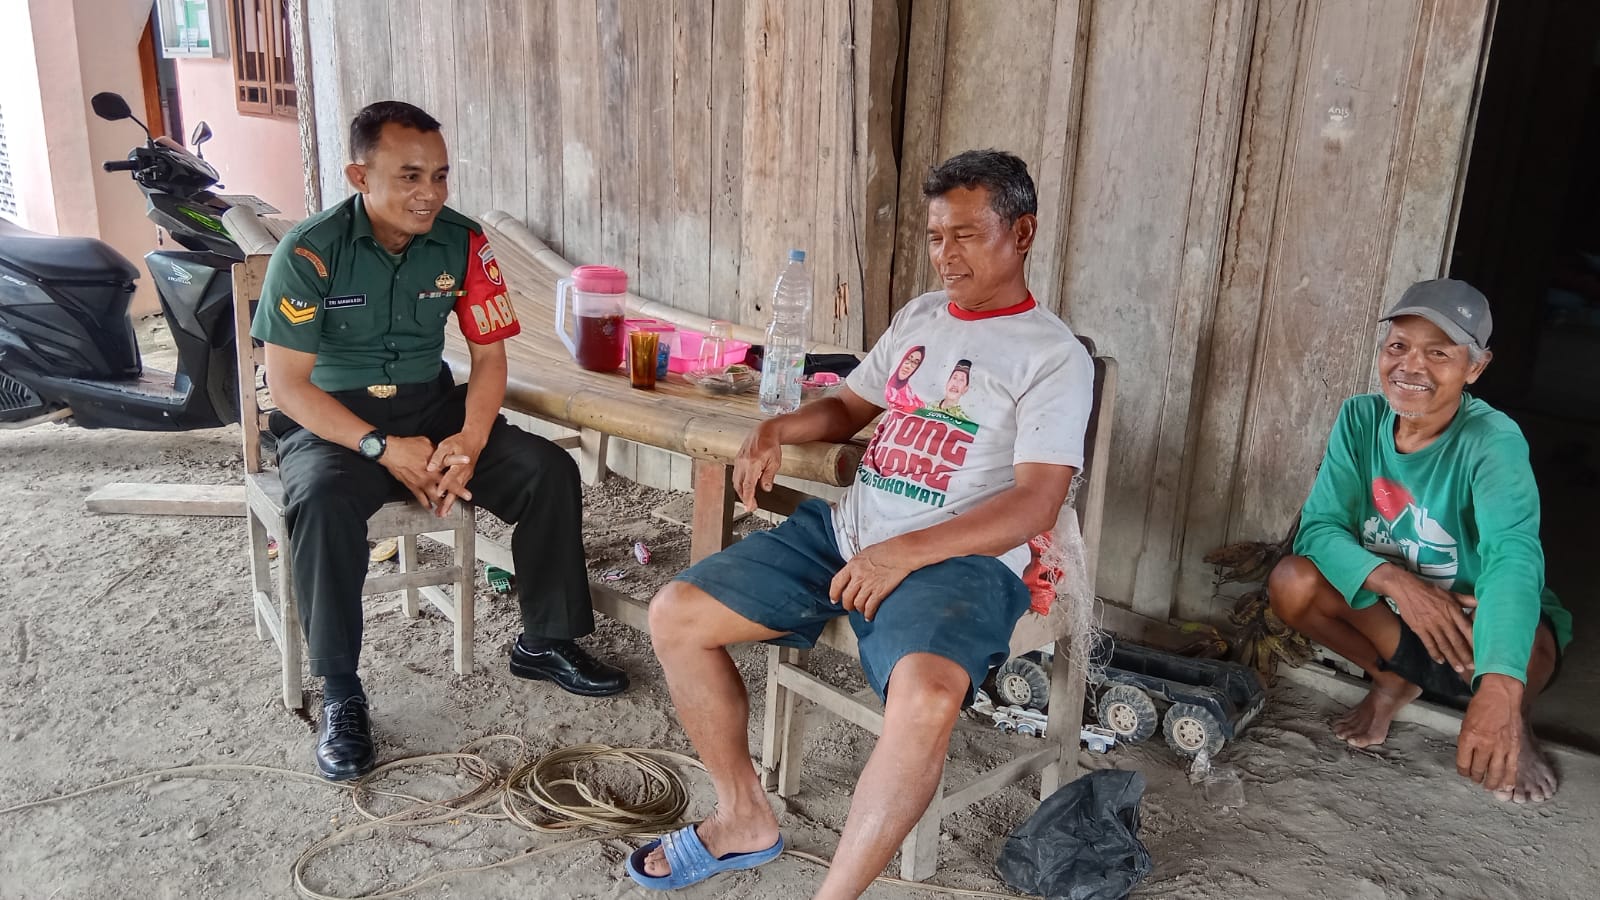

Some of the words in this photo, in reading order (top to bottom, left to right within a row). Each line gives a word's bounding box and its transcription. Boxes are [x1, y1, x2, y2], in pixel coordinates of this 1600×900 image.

[167, 276, 192, 285] HONDA
[290, 298, 308, 308] TNI
[878, 410, 974, 466] TONG
